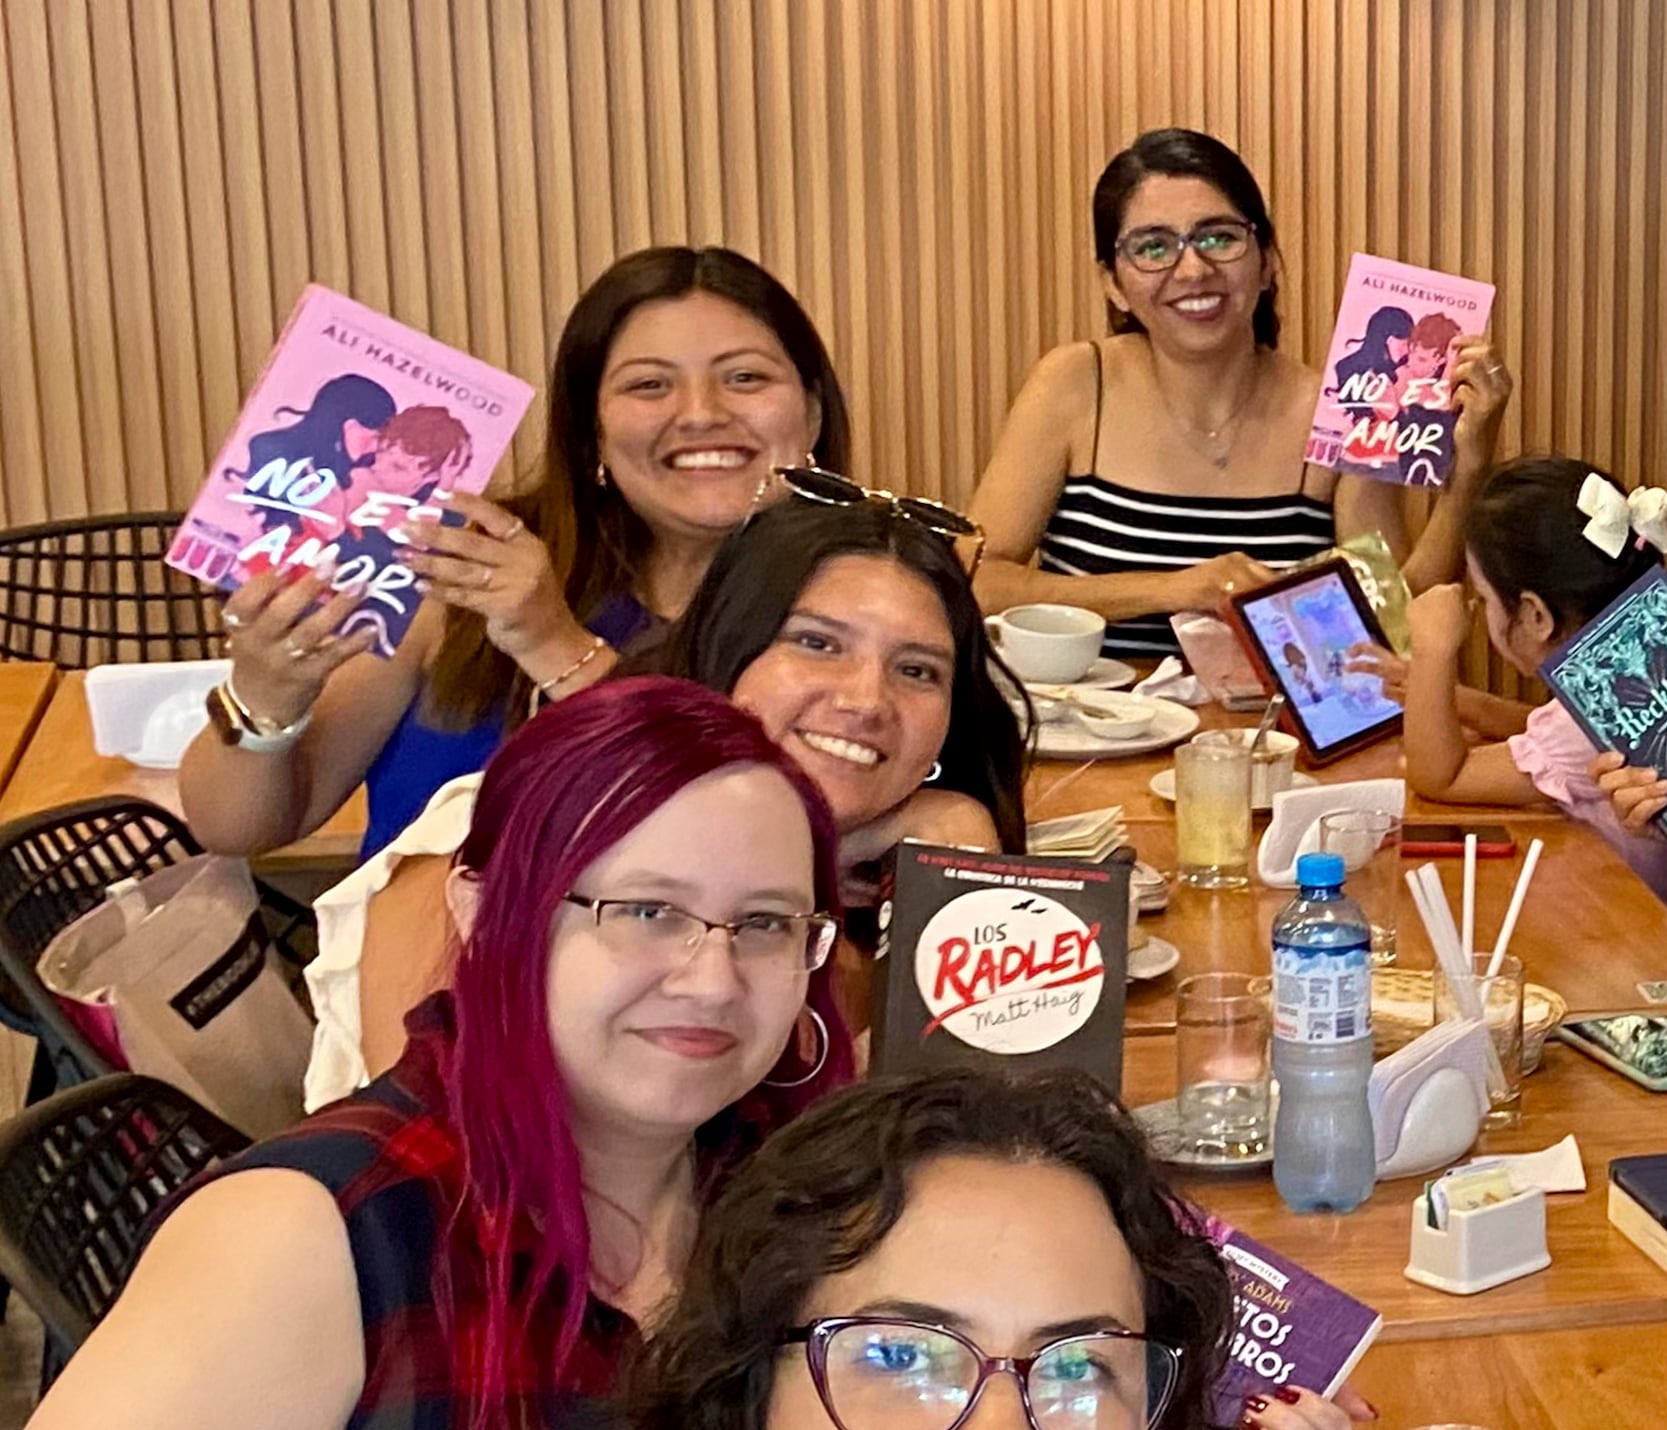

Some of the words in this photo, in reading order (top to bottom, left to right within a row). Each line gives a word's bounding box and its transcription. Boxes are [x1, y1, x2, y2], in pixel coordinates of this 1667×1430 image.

[1362, 276, 1384, 290] ALI
[1390, 283, 1478, 312] HAZELWOOD
[322, 323, 359, 347] ALI
[365, 344, 504, 418] HAZELWOOD
[1339, 370, 1387, 402] NO
[1401, 378, 1450, 410] ES
[1343, 418, 1444, 457] AMOR
[246, 456, 337, 507] NO
[238, 525, 416, 614] AMOR
[974, 923, 1008, 945] LOS
[934, 922, 1101, 1004] RADLEY
[969, 1000, 1031, 1031] Matt
[1033, 991, 1084, 1017] Haig
[1243, 1280, 1293, 1315] ADAMS
